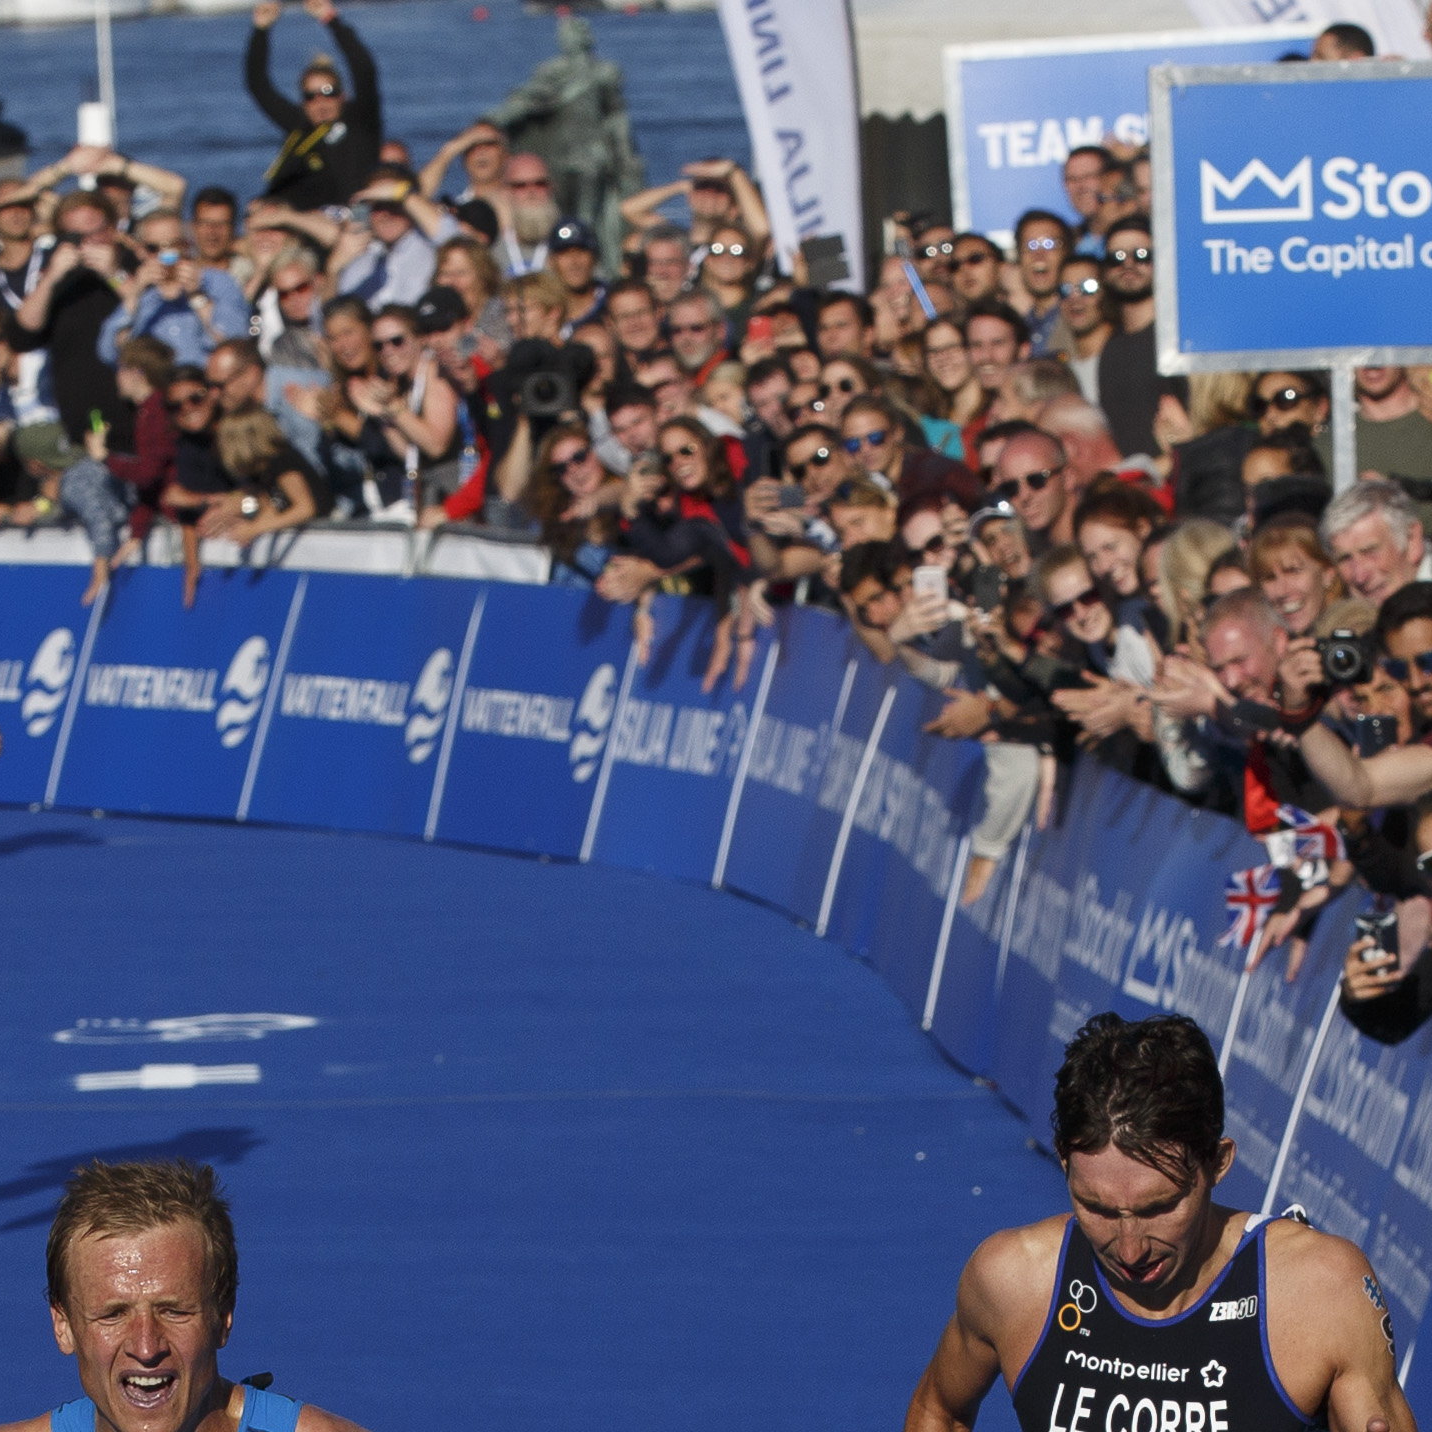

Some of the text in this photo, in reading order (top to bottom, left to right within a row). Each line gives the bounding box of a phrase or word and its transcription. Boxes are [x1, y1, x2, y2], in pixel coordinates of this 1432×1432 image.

[1112, 112, 1149, 148] S
[1203, 239, 1273, 274] The
[1280, 233, 1414, 278] Capital
[85, 663, 217, 712] VATTENFALL
[1065, 1350, 1190, 1383] Montpellier
